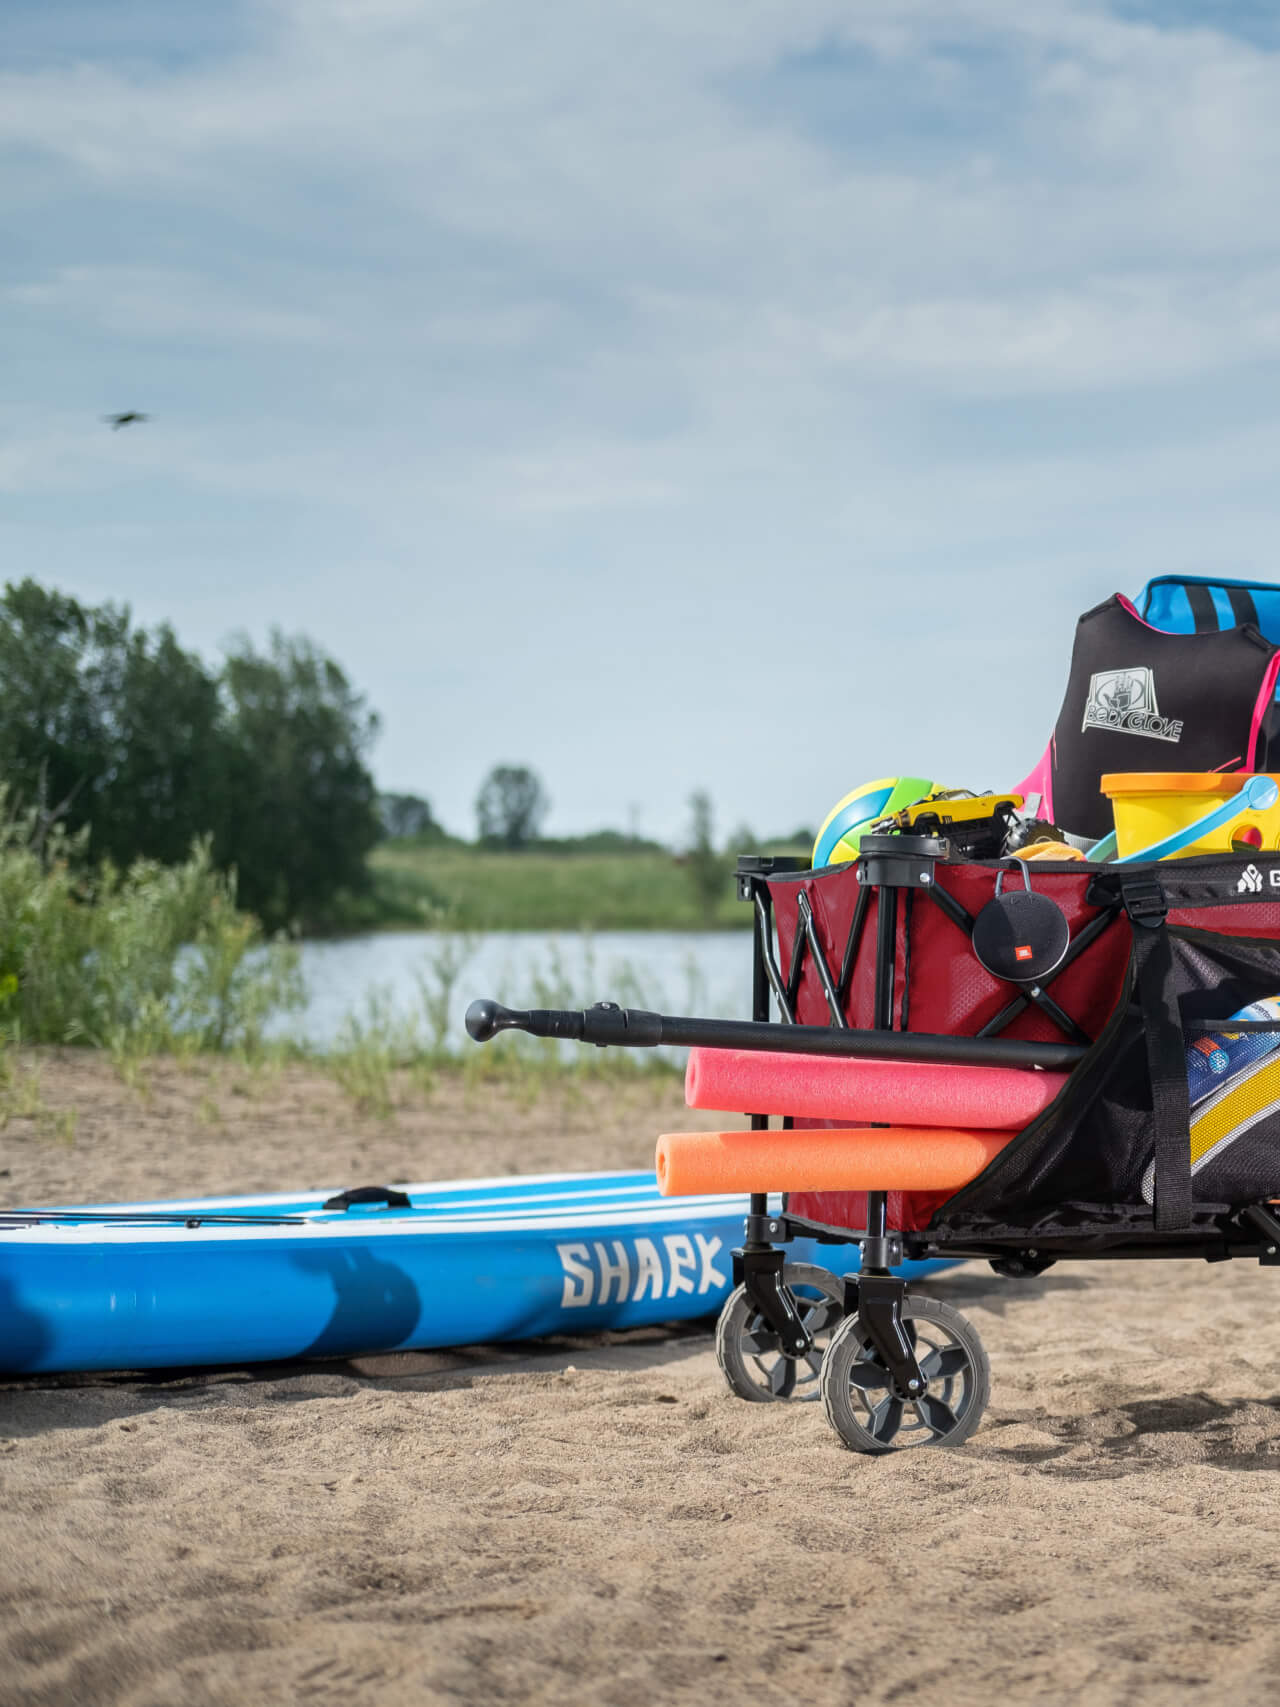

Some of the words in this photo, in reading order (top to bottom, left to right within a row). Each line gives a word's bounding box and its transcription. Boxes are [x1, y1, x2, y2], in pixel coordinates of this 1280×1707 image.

[1086, 704, 1128, 728] BODY
[1127, 710, 1184, 740] GLOVE
[556, 1233, 727, 1308] SHARK
